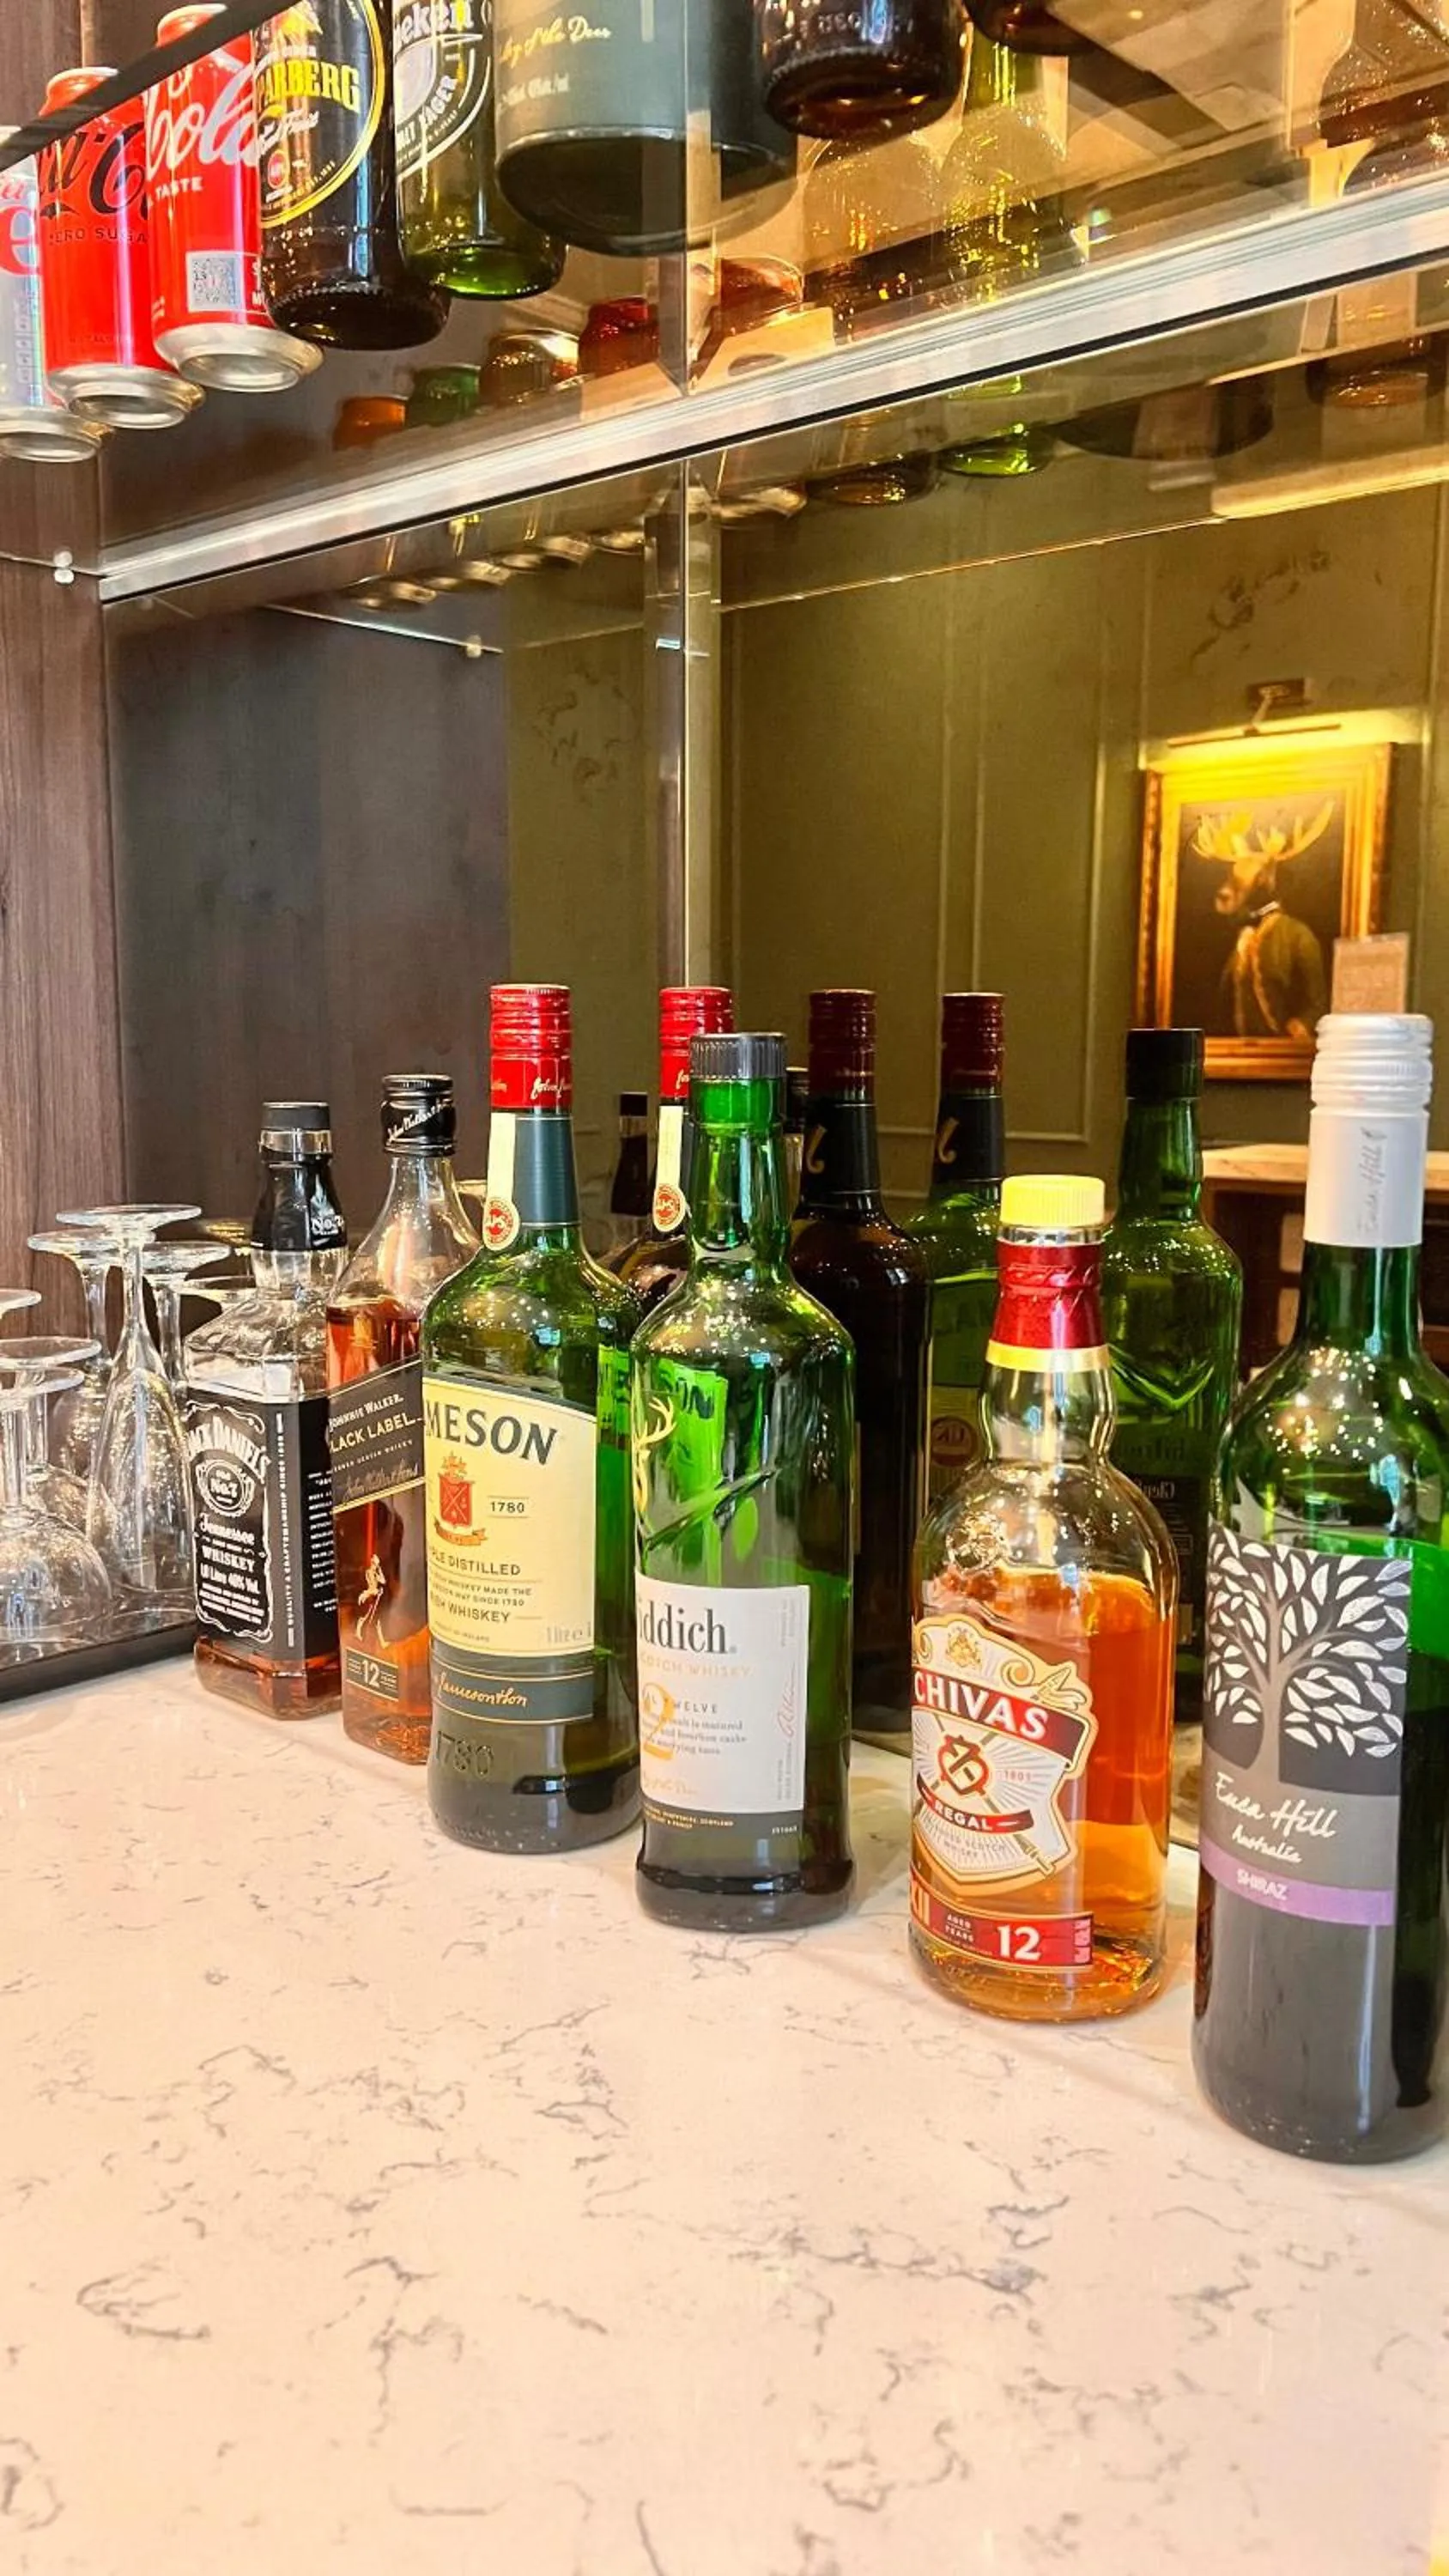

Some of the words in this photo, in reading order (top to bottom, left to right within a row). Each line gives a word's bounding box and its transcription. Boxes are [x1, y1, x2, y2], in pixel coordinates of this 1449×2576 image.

[155, 177, 203, 200] TASTE
[330, 1427, 367, 1453] LACK
[425, 1399, 558, 1467] MESON
[490, 1501, 526, 1515] 1780
[202, 1545, 255, 1573] WHISKEY
[448, 1554, 522, 1577] DISTILLED
[483, 1586, 510, 1595] MADE
[512, 1588, 532, 1597] THE
[447, 1601, 512, 1625] WHISKEY
[363, 1659, 380, 1688] 12
[913, 1670, 1049, 1741] CHIVAS
[934, 1799, 994, 1832] REGAL
[1270, 1800, 1339, 1838] Hill
[1231, 1823, 1303, 1863] Australia
[1236, 1867, 1288, 1902] SHIRAZ
[997, 1924, 1043, 1961] 12
